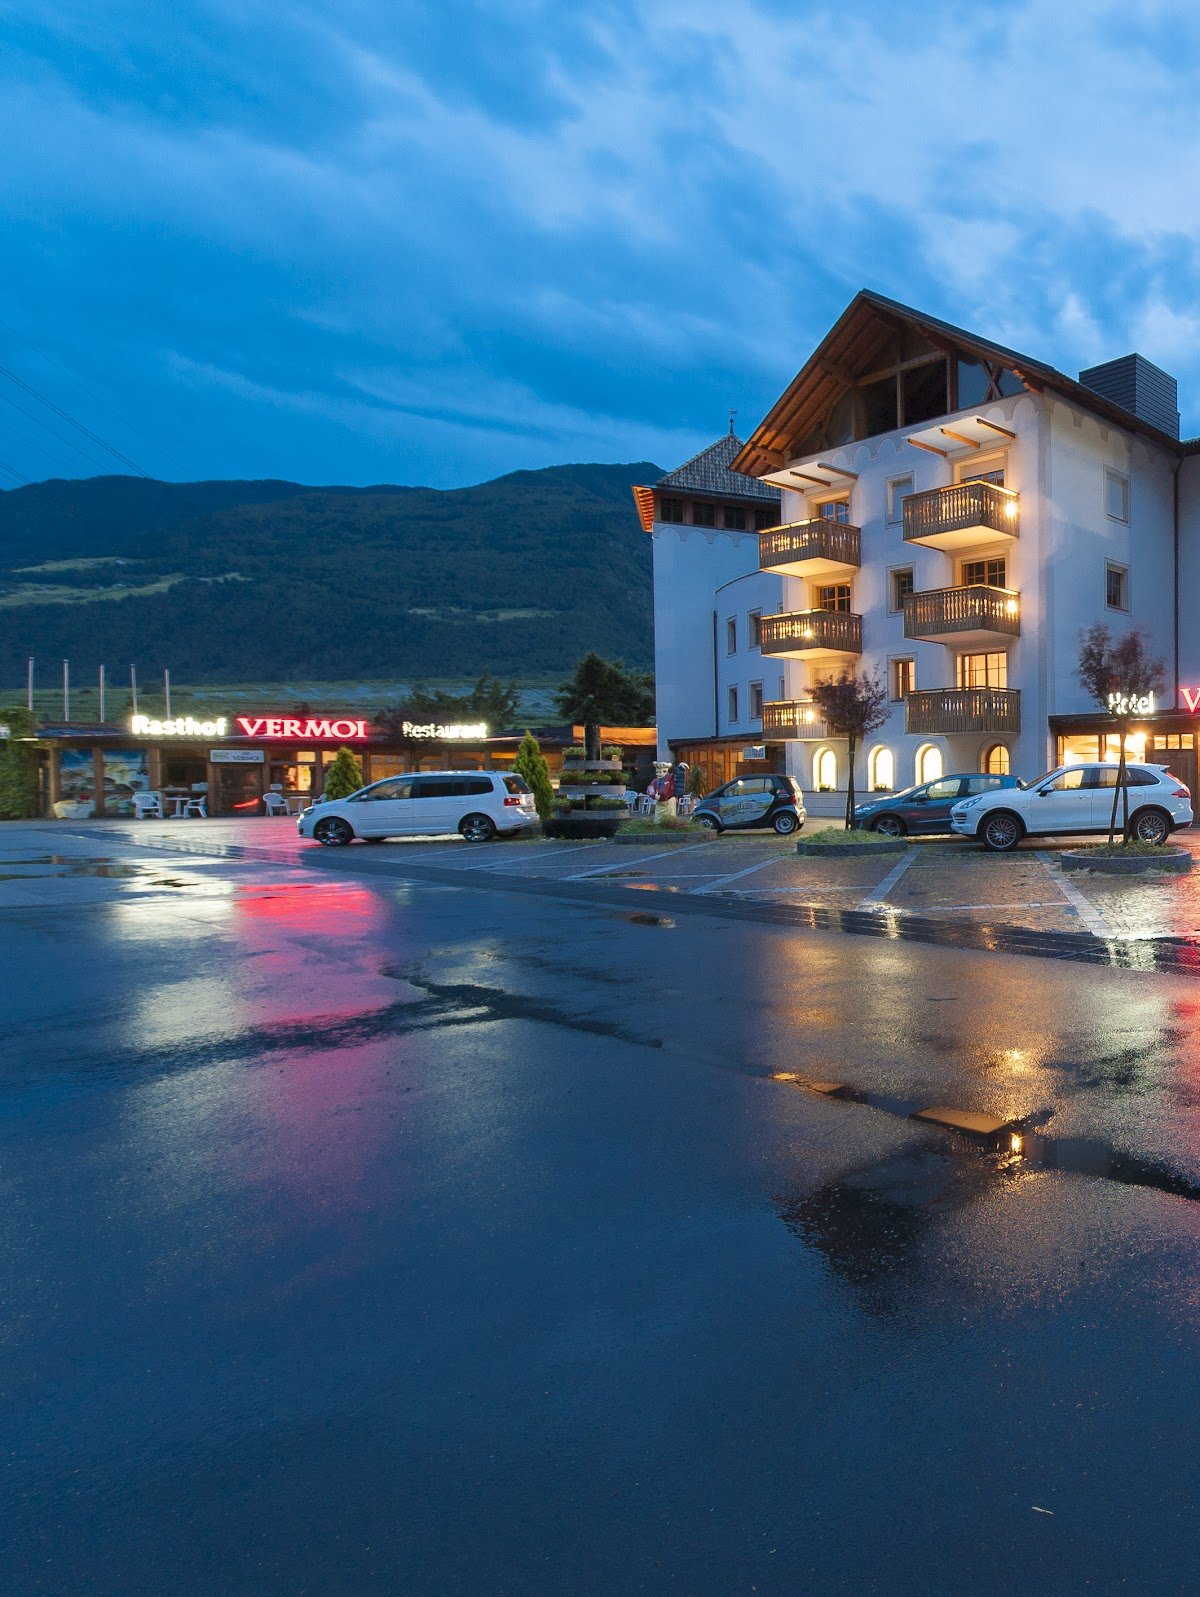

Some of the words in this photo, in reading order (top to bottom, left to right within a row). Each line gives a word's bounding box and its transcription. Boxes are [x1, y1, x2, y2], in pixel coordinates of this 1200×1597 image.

[1108, 690, 1154, 715] Hotel
[131, 714, 227, 737] Rasthof
[237, 717, 368, 738] VERMOI
[402, 721, 488, 738] Restaurant
